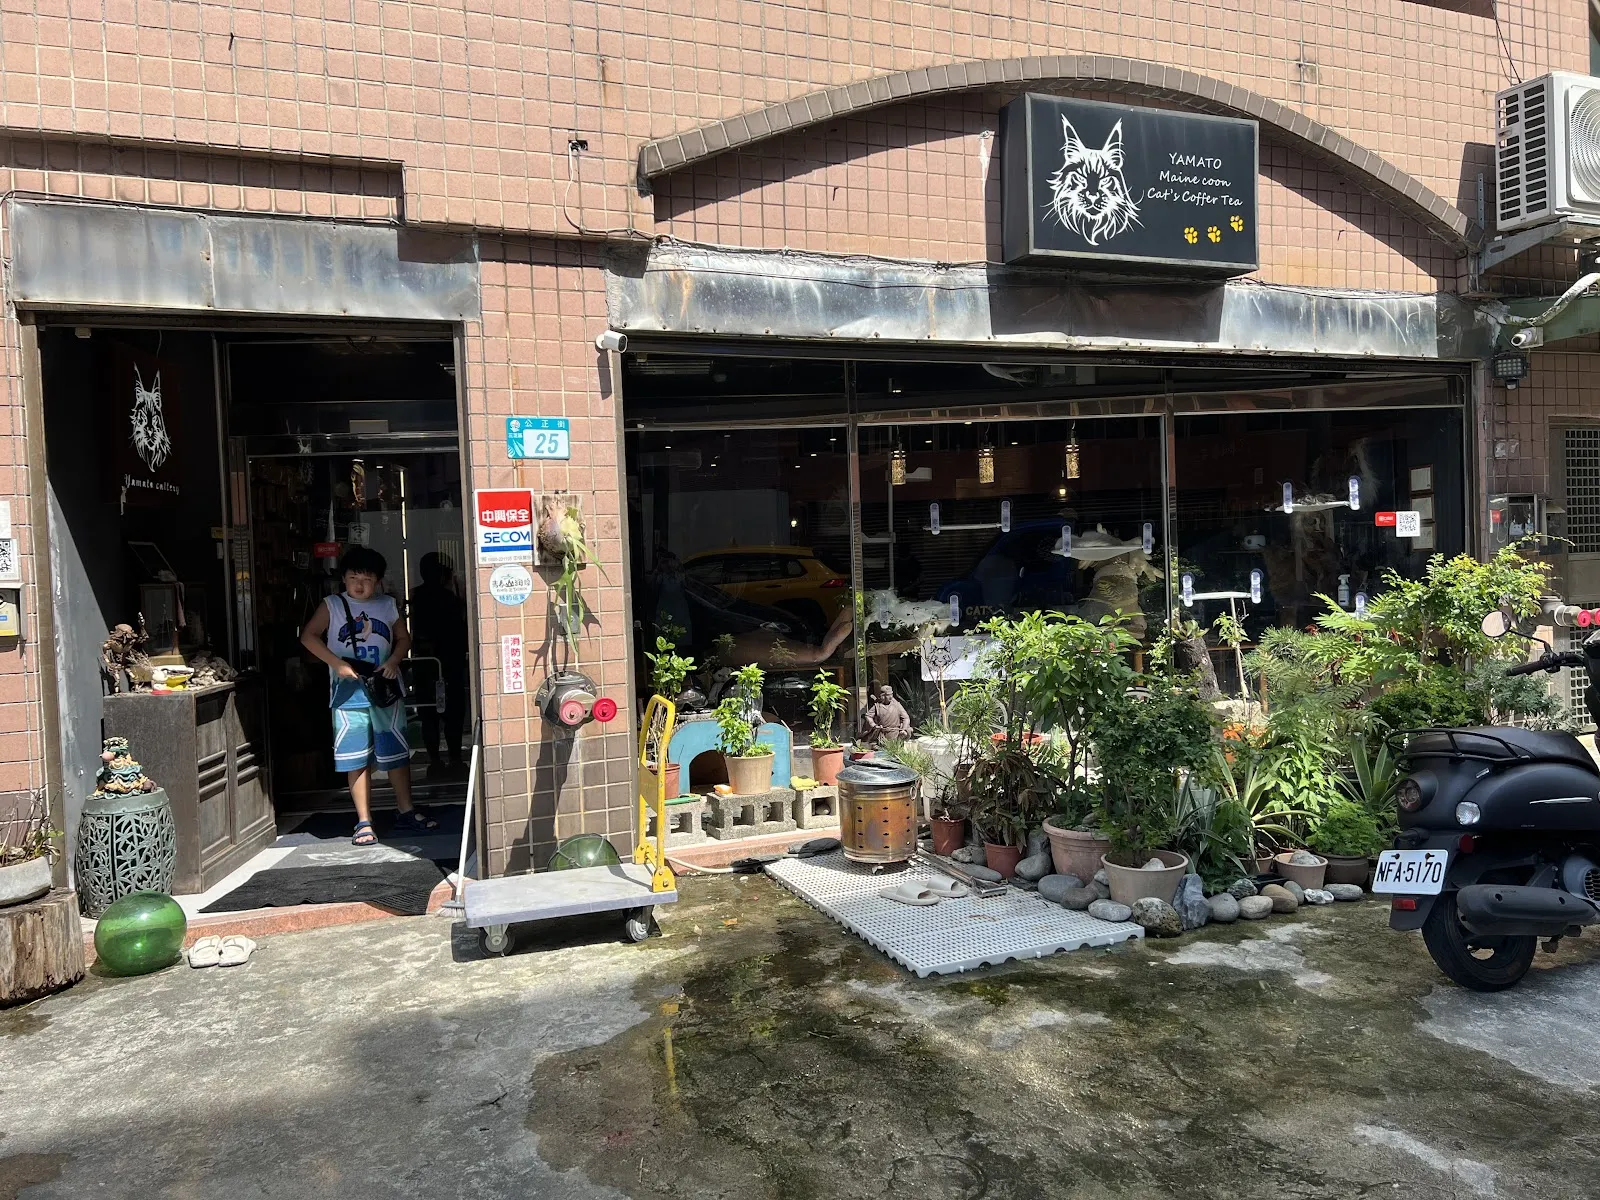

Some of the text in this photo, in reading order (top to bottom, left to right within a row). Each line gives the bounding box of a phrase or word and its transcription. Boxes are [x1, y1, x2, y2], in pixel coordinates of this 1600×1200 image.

[1168, 152, 1222, 169] YAMATO
[1159, 170, 1231, 187] Maine coon
[1147, 187, 1180, 202] Cat's
[1220, 195, 1243, 207] Tea
[534, 432, 559, 454] 25
[481, 509, 530, 523] 中興保全
[483, 531, 531, 544] SECOM
